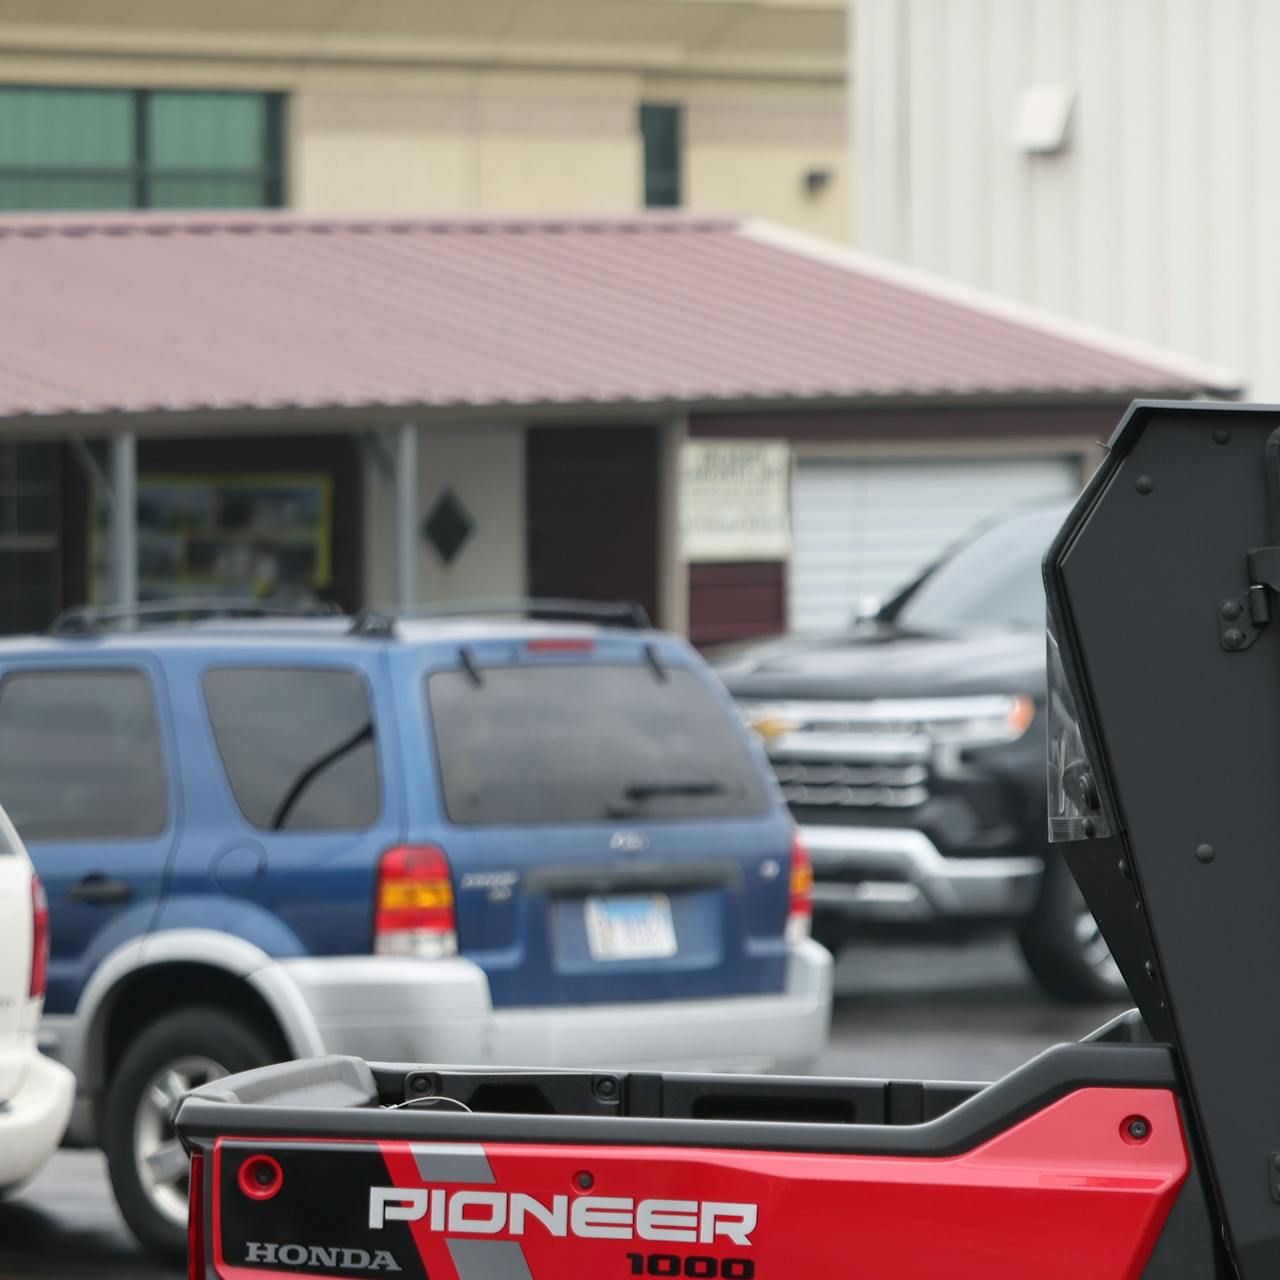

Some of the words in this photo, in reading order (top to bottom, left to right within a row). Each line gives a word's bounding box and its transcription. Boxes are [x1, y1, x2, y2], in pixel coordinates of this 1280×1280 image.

[368, 1186, 758, 1246] PIONEER
[244, 1241, 402, 1271] HONDA
[625, 1252, 756, 1280] 1000
